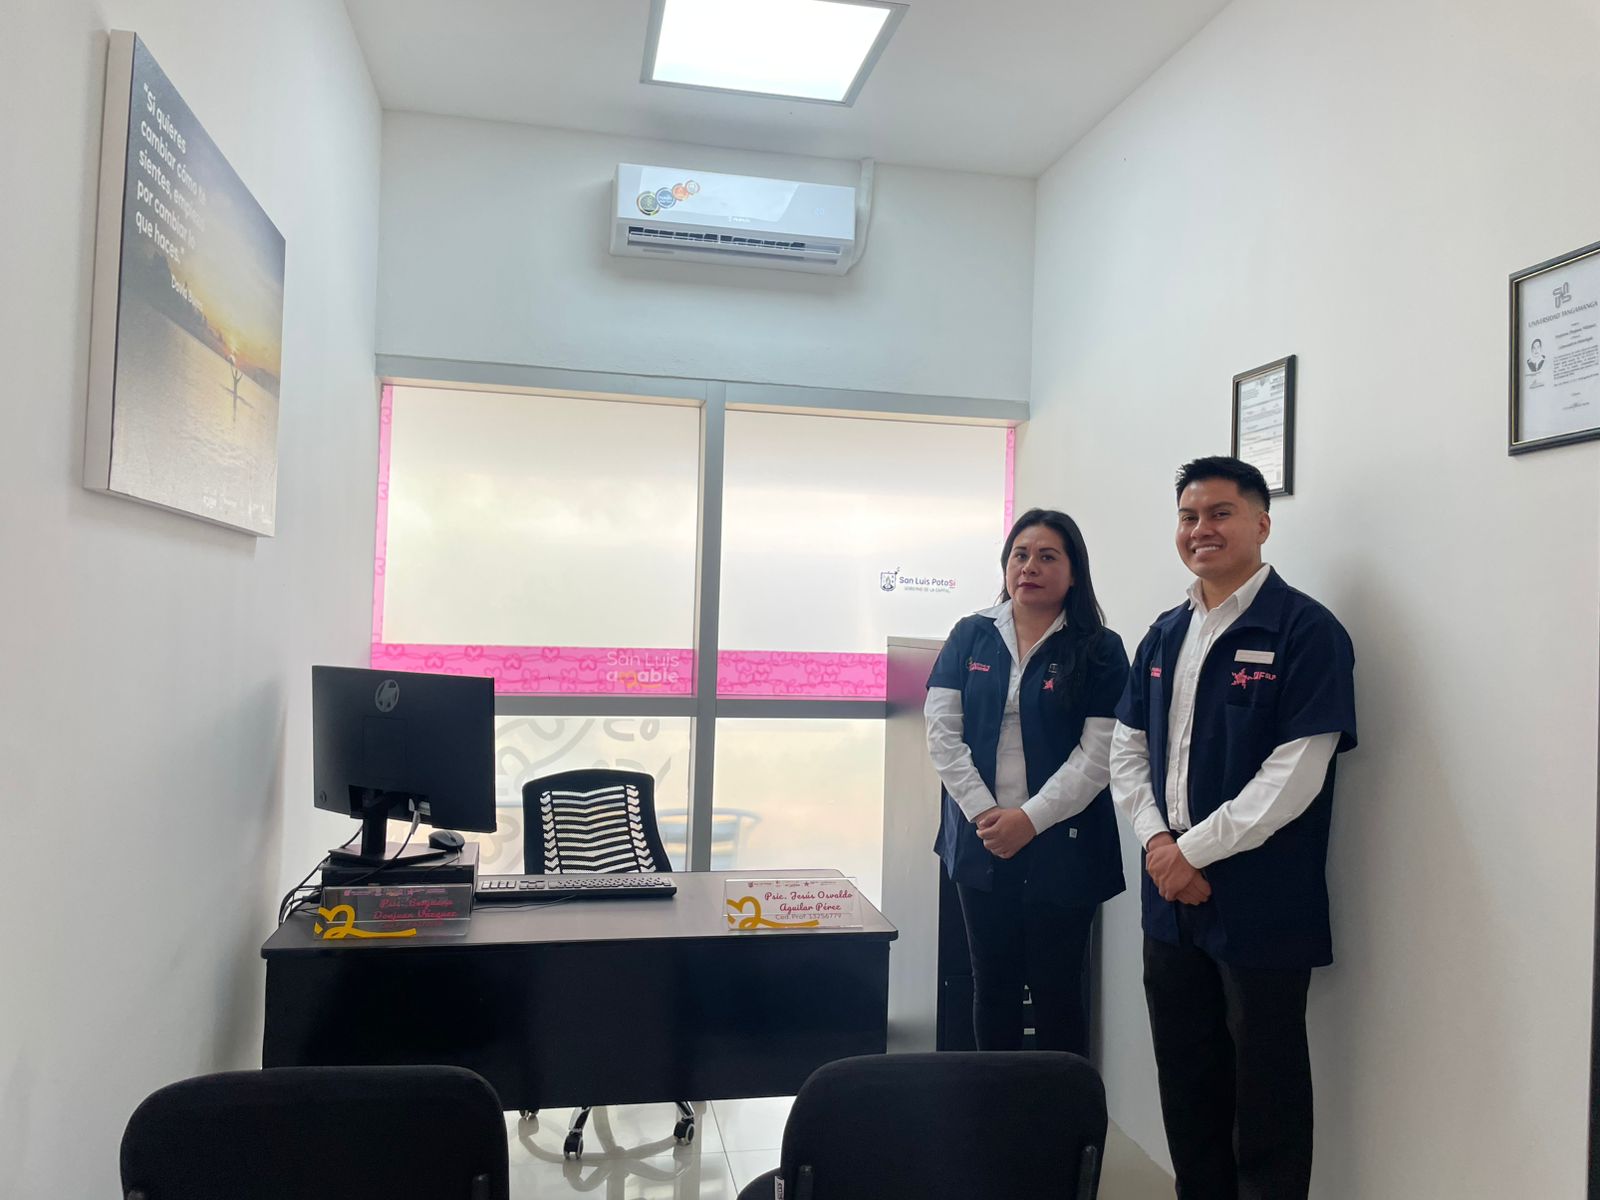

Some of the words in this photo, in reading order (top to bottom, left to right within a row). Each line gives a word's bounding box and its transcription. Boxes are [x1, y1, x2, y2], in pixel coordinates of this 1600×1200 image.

[156, 106, 187, 154] quieres
[141, 120, 176, 170] cambiar
[176, 163, 197, 196] cómo
[139, 149, 172, 200] sientes,
[137, 179, 153, 206] por
[154, 198, 187, 240] cambiar
[135, 210, 153, 238] que
[899, 576, 914, 584] San
[915, 577, 930, 585] Luis
[606, 651, 640, 666] San
[644, 652, 680, 667] Luis
[779, 902, 813, 915] Aguilar
[815, 901, 842, 912] Pérez
[790, 890, 815, 902] Jesús
[817, 889, 853, 899] Osvaldo
